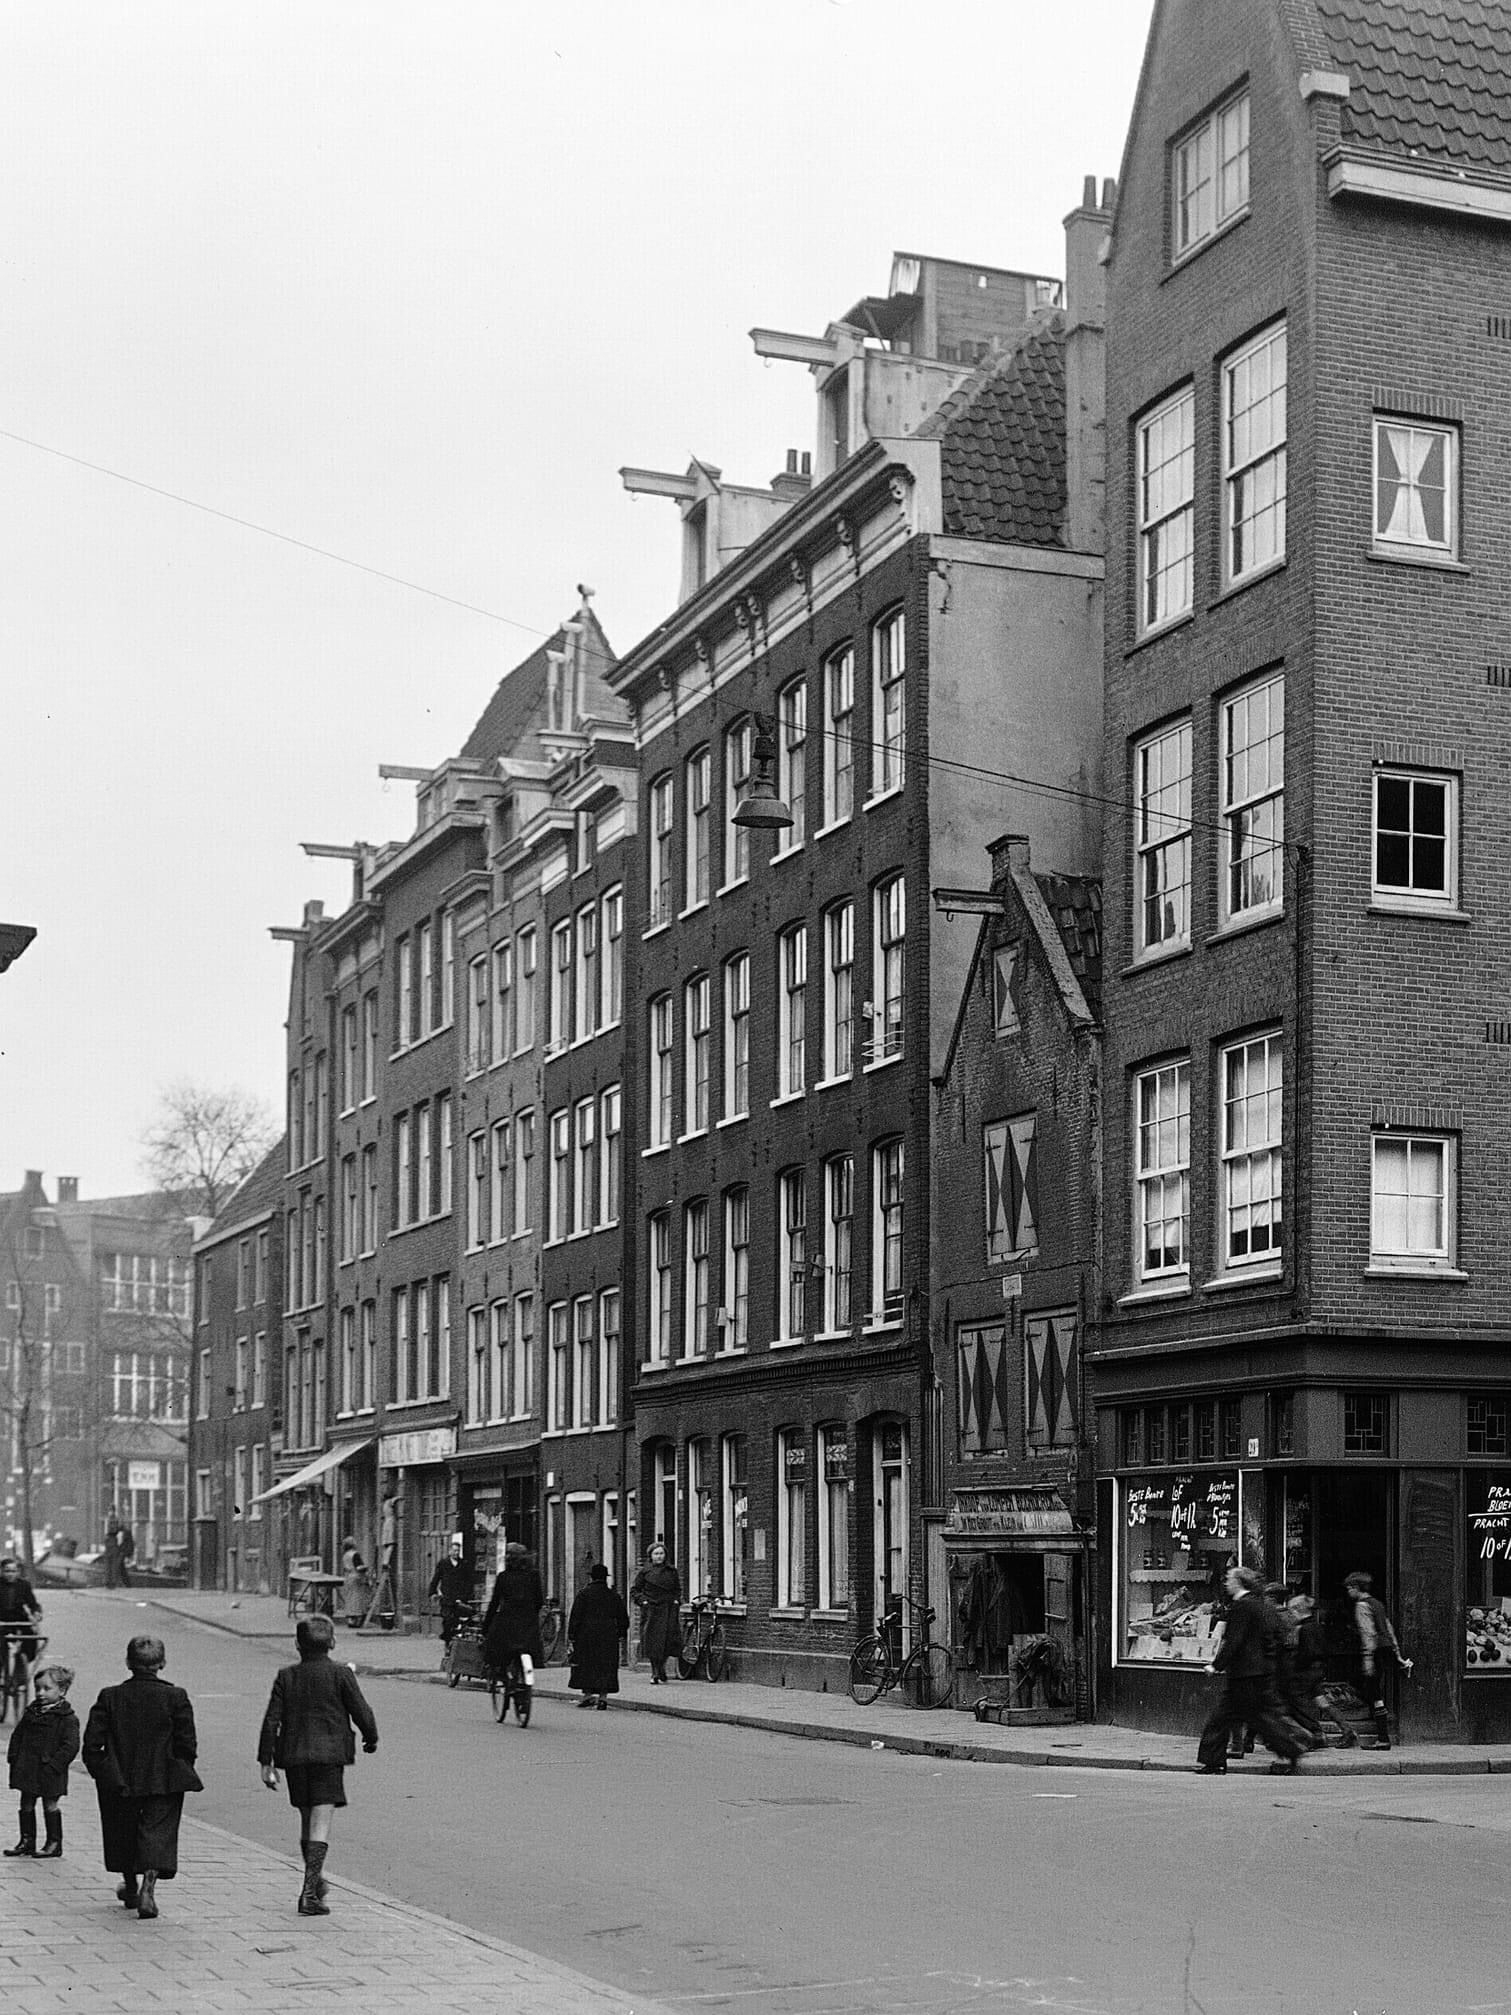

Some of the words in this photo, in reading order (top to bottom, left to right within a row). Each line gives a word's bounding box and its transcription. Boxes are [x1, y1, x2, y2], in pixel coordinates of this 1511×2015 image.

[1170, 1504, 1181, 1529] 10
[1209, 1506, 1219, 1535] 5
[1473, 1517, 1510, 1530] PRACHT
[1480, 1536, 1496, 1559] 10
